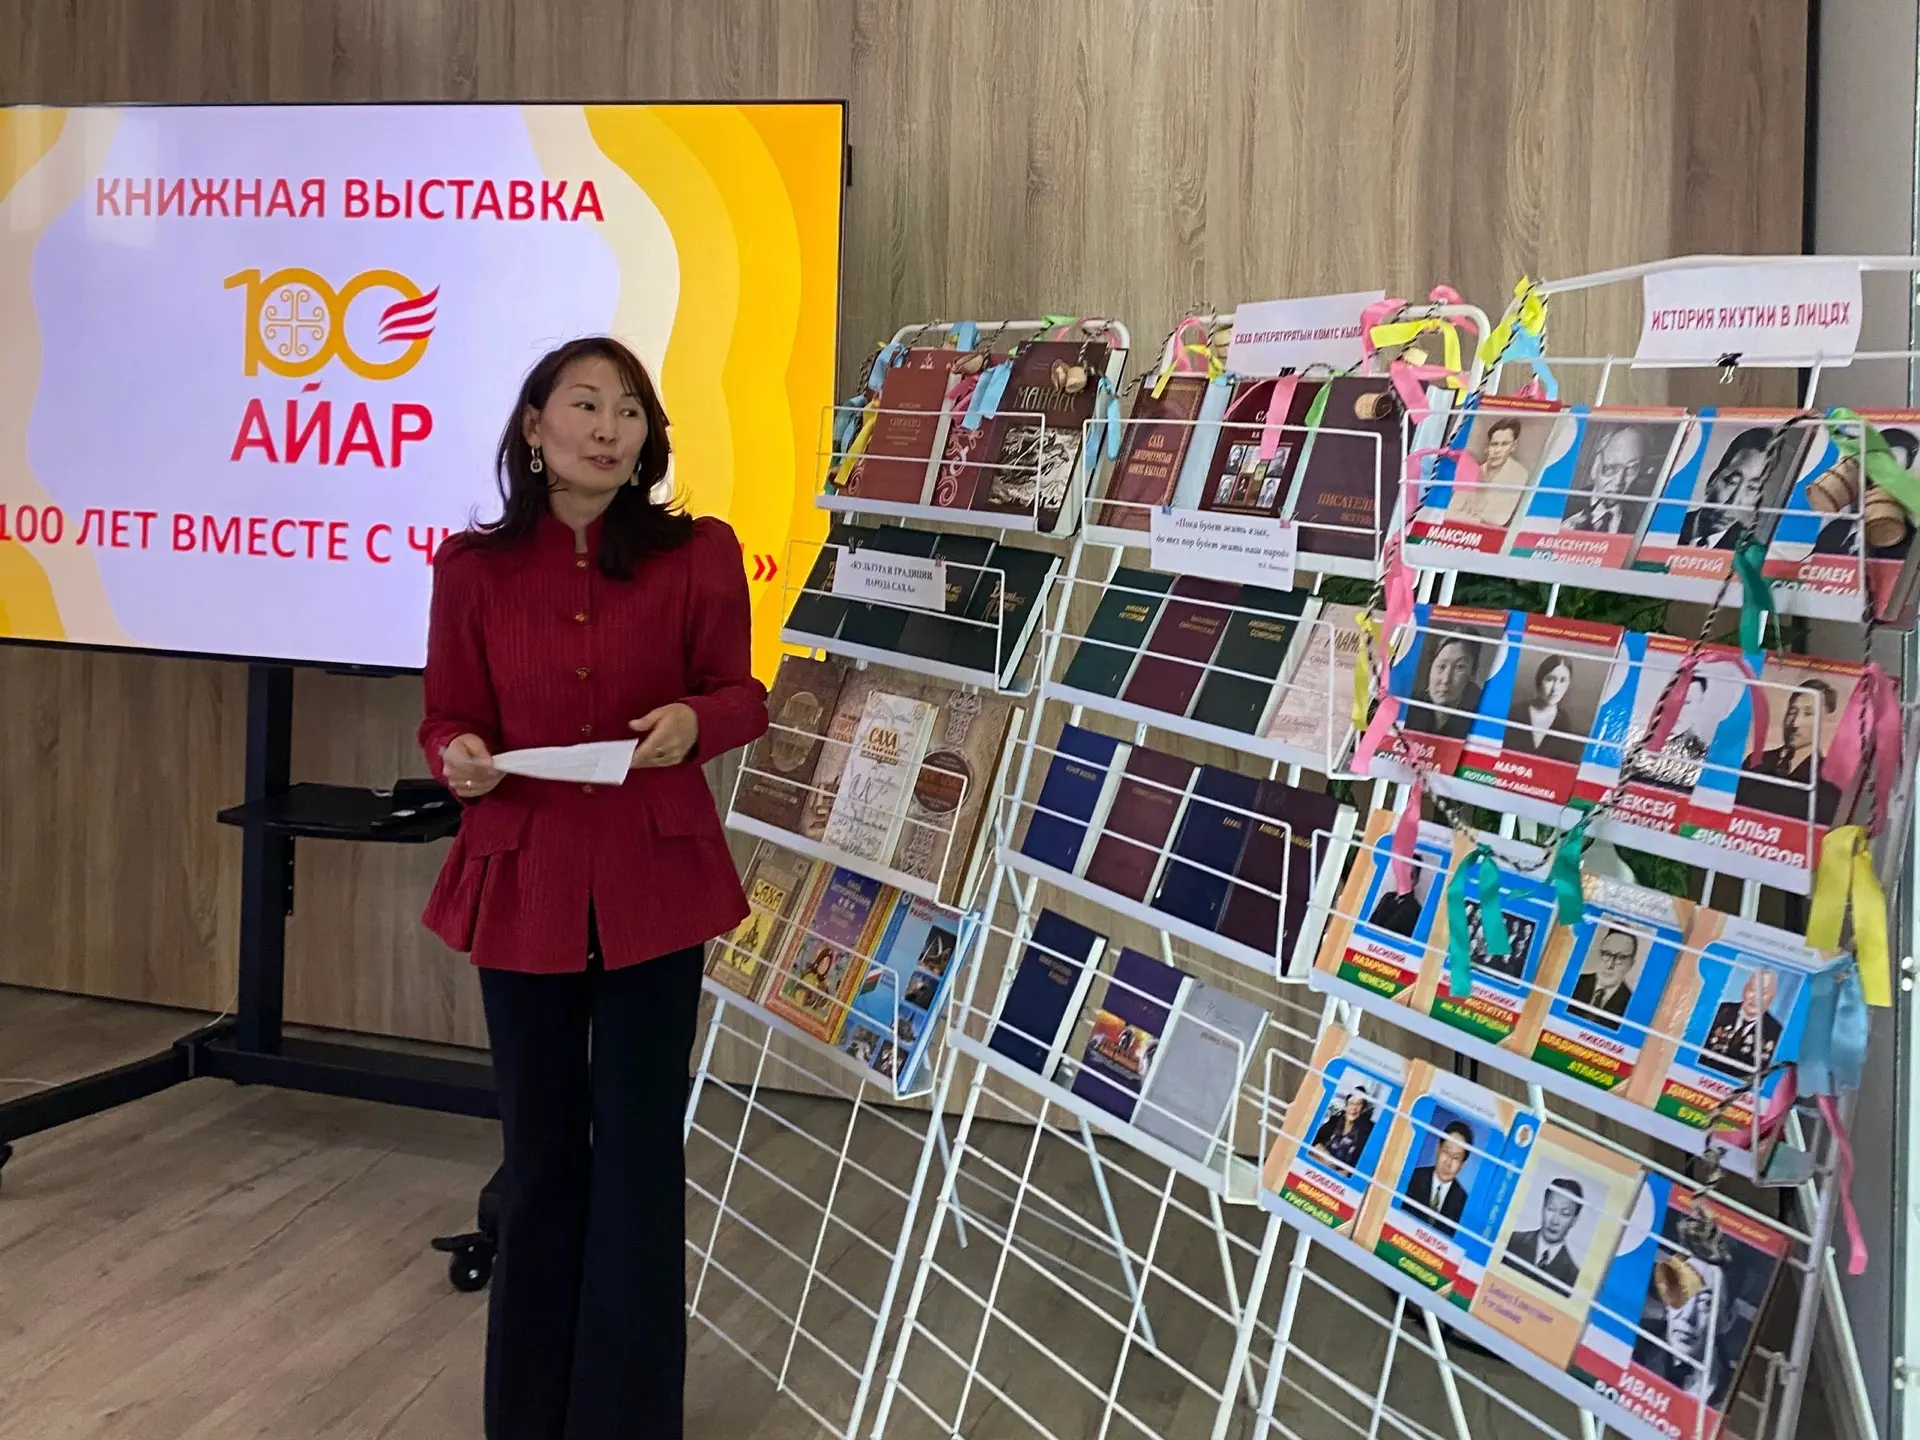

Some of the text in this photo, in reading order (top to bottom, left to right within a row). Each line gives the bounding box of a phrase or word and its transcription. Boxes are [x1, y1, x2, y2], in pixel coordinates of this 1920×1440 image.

[96, 177, 605, 223] КНИЖНАЯ ВЫСТАВКА
[1651, 302, 1851, 331] ИСТОРИЯ ЯКУТИИ В ЛИЦАХ
[230, 379, 434, 469] АЙАР
[76, 508, 158, 549] ЛЕТ
[172, 513, 350, 561] ВМЕСТЕ
[365, 523, 392, 563] С
[1426, 525, 1483, 546] МАКСИМ
[1535, 536, 1609, 554] АВКСЕНТИЙ
[894, 566, 933, 580] ТРАДИЦИИ
[1664, 554, 1724, 573] ГЕОРГИЙ
[1798, 564, 1855, 584] СЕМЕН
[869, 727, 898, 749] САХА
[1493, 761, 1534, 779] МАРФА
[1727, 817, 1782, 844] ИЛЬЯ
[1352, 952, 1402, 980] НАЗАРОВИЧ
[1367, 943, 1406, 964] ВАСИЛИЙ
[1541, 1032, 1620, 1072] ВЛАДИМИРОВИЧ
[1578, 1030, 1625, 1055] НИКОЛАЙ
[1567, 1060, 1614, 1086] АТЛАСОВ
[1618, 1371, 1671, 1413] ИВАН
